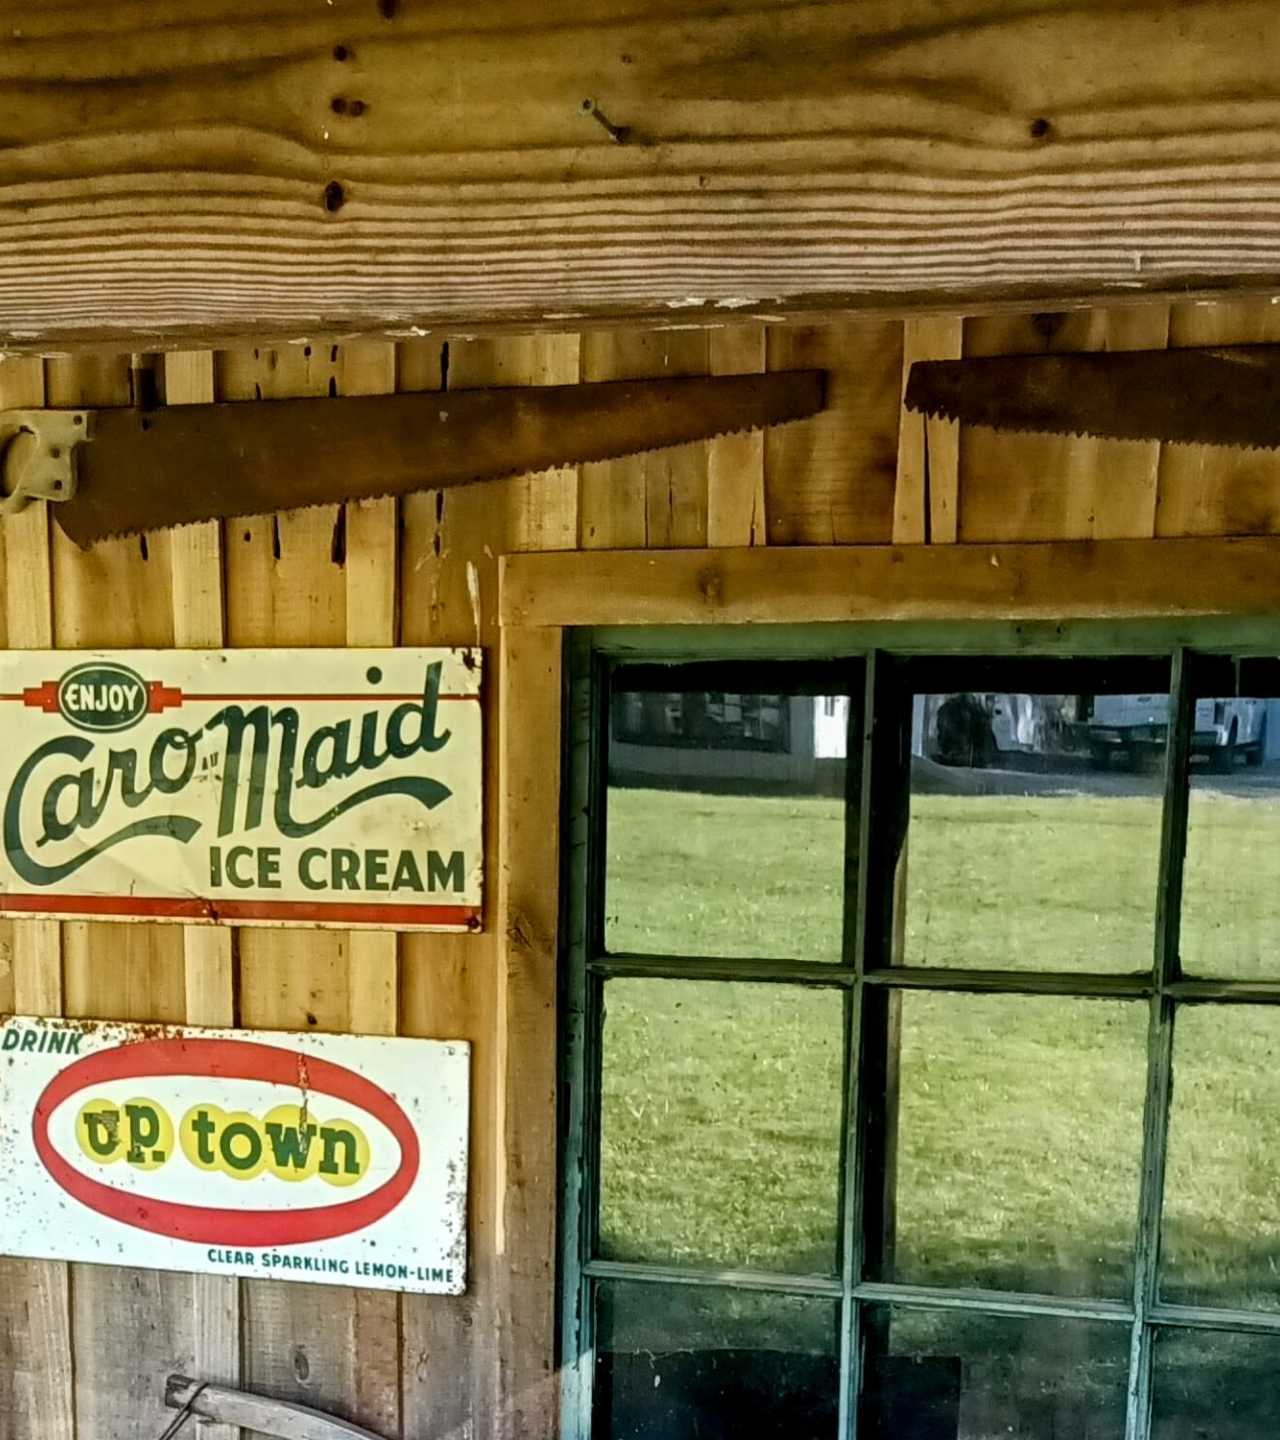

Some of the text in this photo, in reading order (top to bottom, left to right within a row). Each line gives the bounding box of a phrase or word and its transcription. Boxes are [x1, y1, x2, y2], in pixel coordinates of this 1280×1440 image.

[64, 683, 139, 712] ENJOY
[3, 660, 452, 886] Caro Maid
[210, 845, 465, 892] ICE CREAM
[1, 1028, 84, 1056] DRINK
[207, 1248, 454, 1283] CLEAR SPARKLING LEMON-LIME
